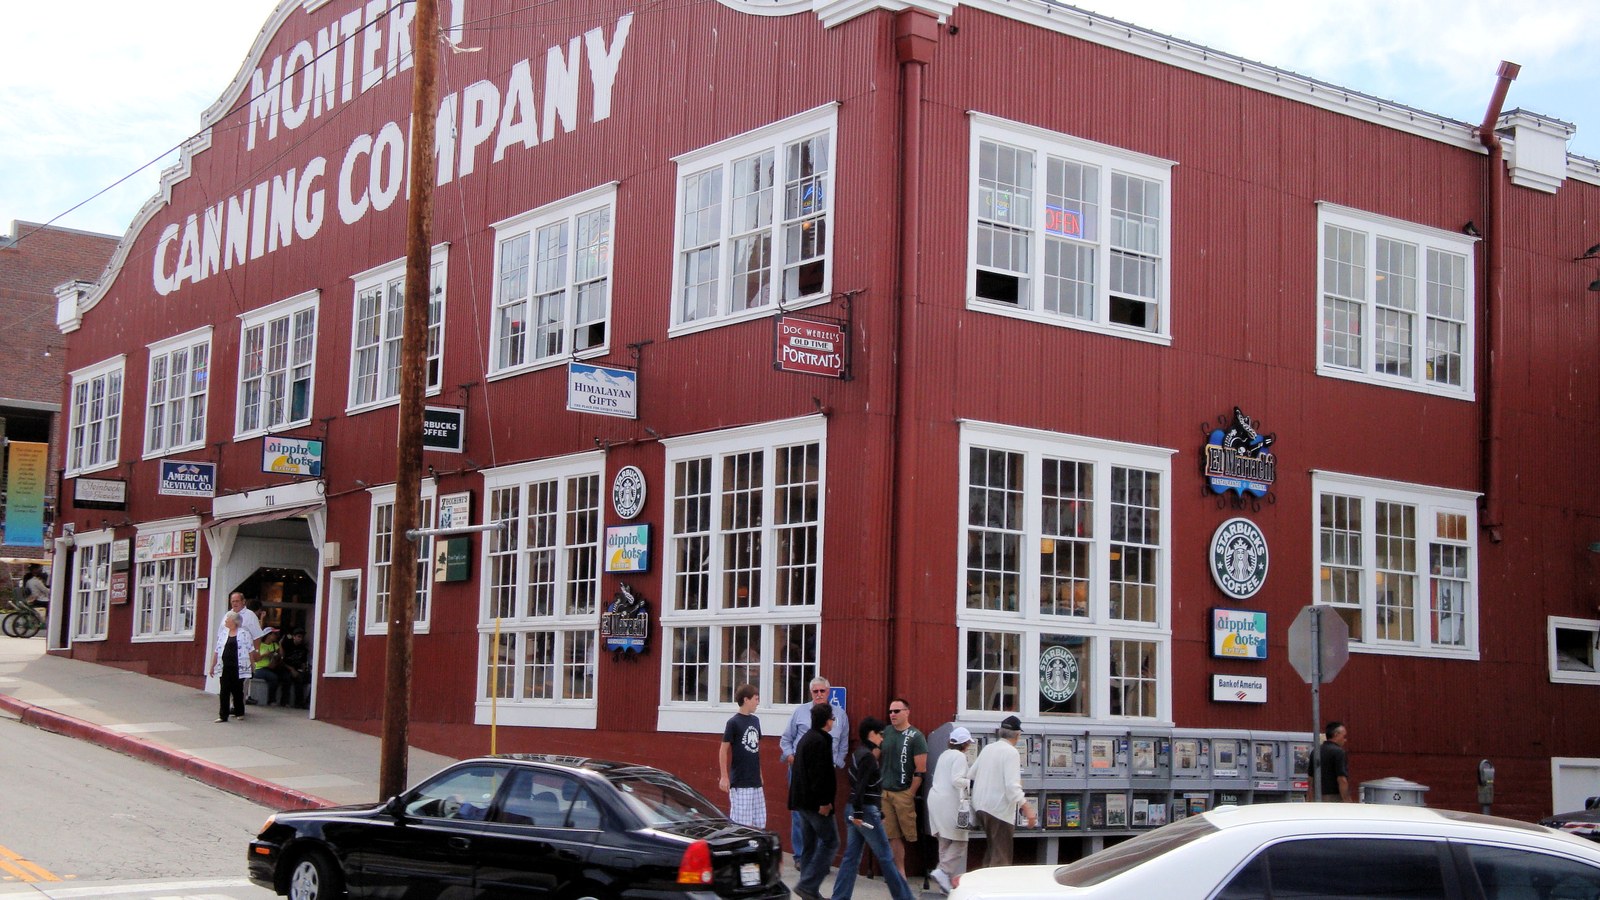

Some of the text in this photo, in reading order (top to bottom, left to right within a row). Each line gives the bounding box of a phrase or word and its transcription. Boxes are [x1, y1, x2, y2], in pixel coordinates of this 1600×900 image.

[247, 0, 464, 152] MONTER
[153, 156, 327, 296] CANNING
[1045, 208, 1080, 234] OPEN
[784, 325, 802, 335] DOC
[794, 338, 828, 349] OLD TIME
[783, 345, 840, 368] PORTRAITS
[575, 382, 631, 398] HIMALAYAN
[589, 395, 617, 407] GIFTS
[424, 420, 458, 431] RBUCKS
[424, 428, 449, 437] OFFEE
[286, 456, 314, 467] dots
[1209, 446, 1275, 482] El Mariachi
[167, 471, 209, 482] AMERICAN
[615, 469, 641, 492] STARBUCKS
[163, 480, 197, 490] REVIVAL
[617, 503, 638, 517] COFFEE
[1216, 522, 1265, 556] STARBUCKS
[621, 546, 642, 560] dots
[1221, 573, 1260, 595] COFFEE
[1234, 633, 1261, 646] dots
[1040, 648, 1077, 673] STARBUCKS
[1218, 678, 1263, 690] Bank of America
[1043, 685, 1073, 700] COFFEE
